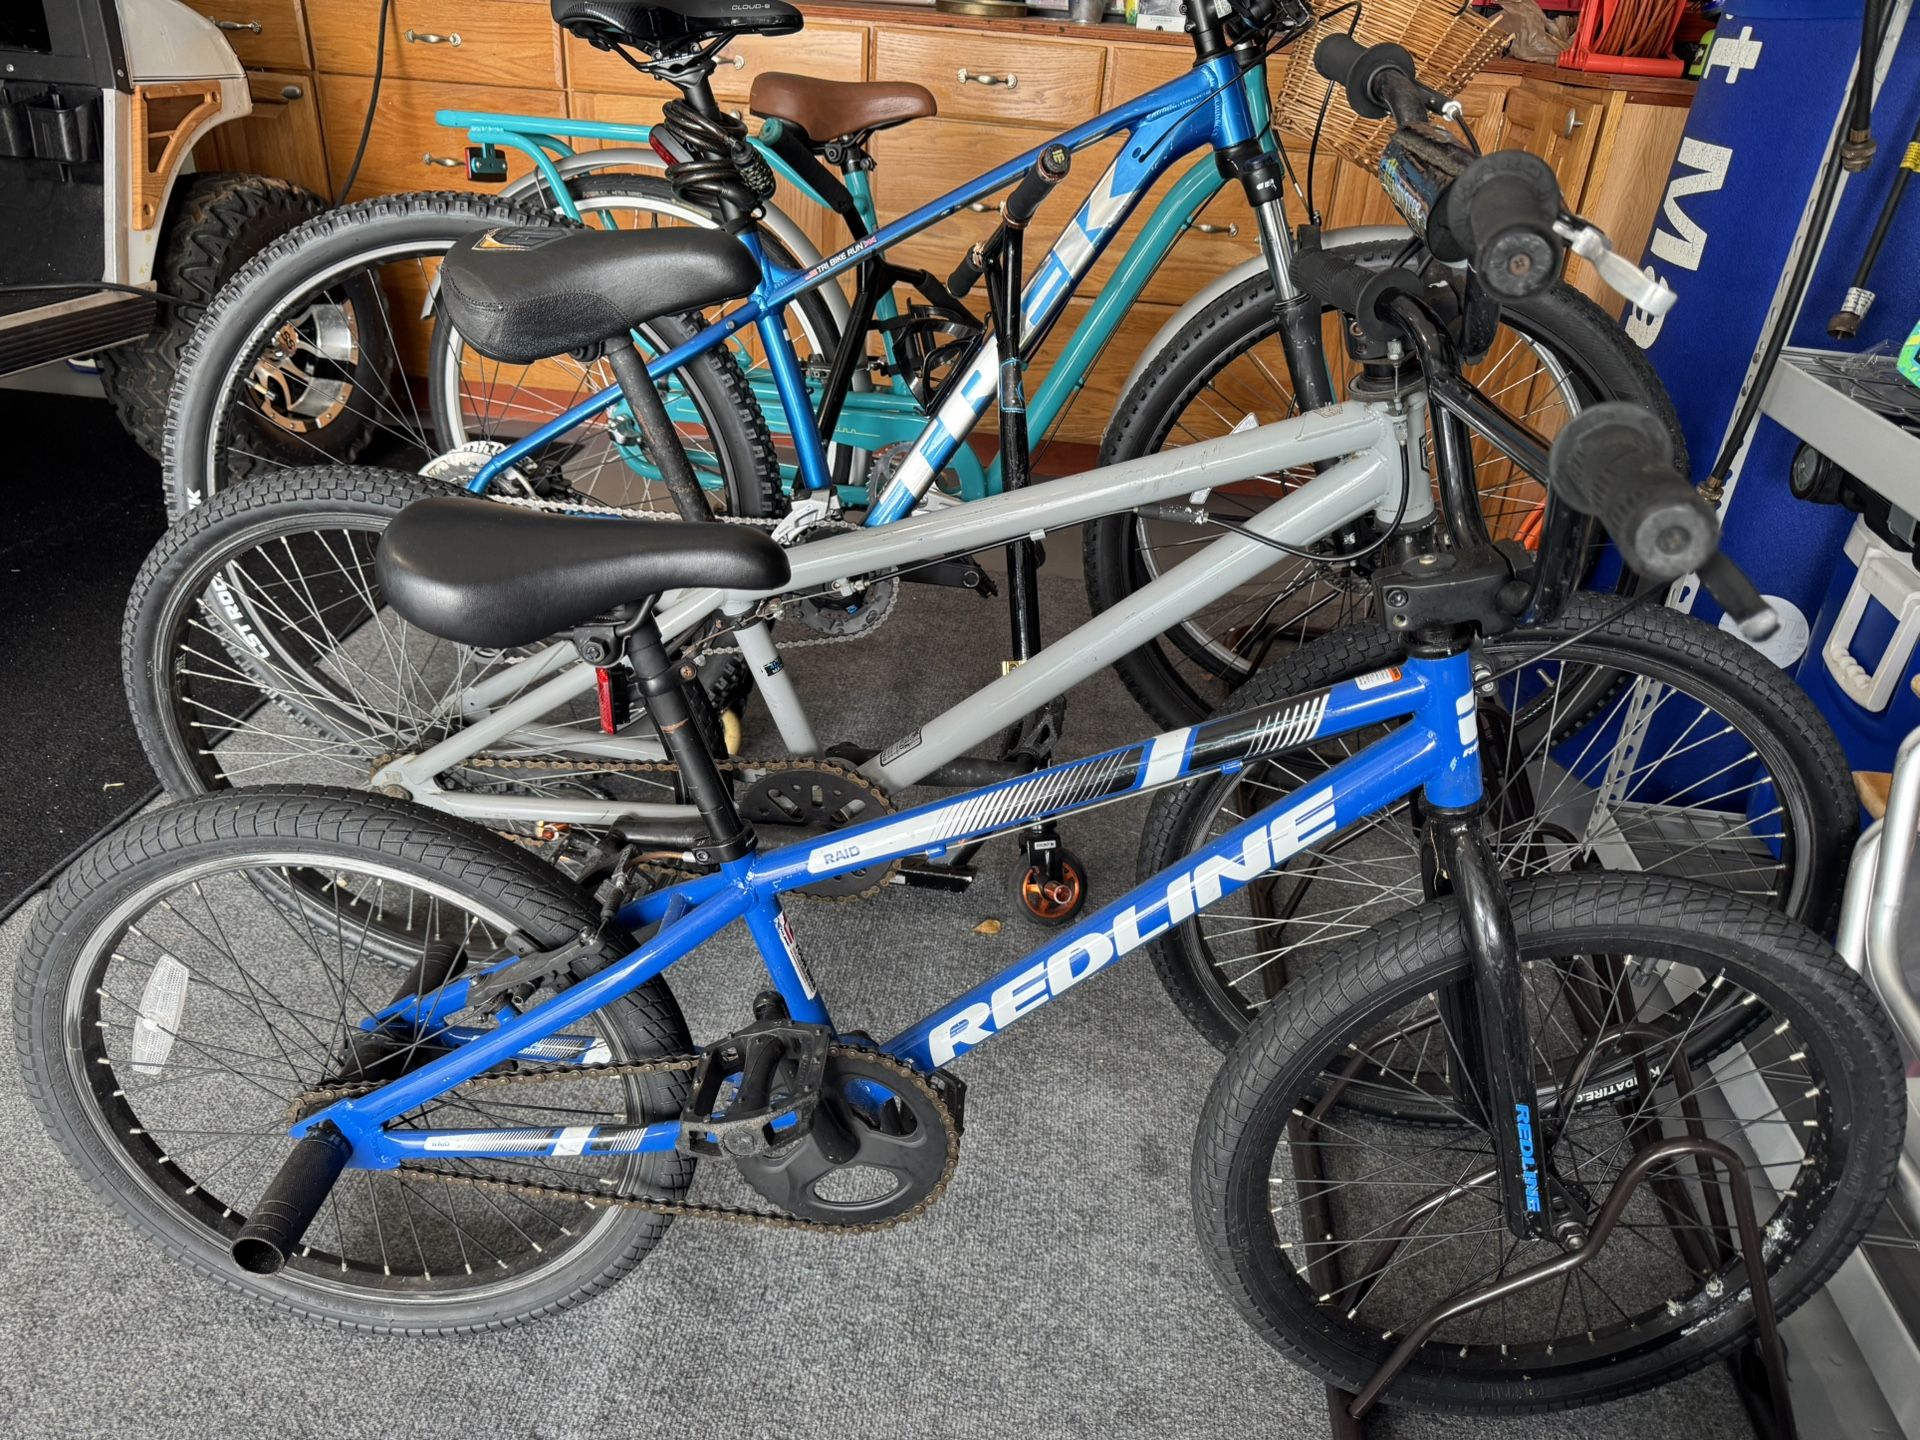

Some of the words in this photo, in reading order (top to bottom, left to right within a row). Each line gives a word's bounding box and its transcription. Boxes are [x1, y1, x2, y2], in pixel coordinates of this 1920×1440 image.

[816, 262, 829, 273] TRI
[829, 252, 847, 267] BIKE
[846, 242, 864, 257] RUN
[880, 160, 1141, 502] TREK
[211, 572, 243, 621] ROC
[234, 622, 271, 659] CST
[823, 845, 860, 864] RAID
[928, 785, 1337, 1067] REDLINE
[1515, 1103, 1541, 1212] REDLINE
